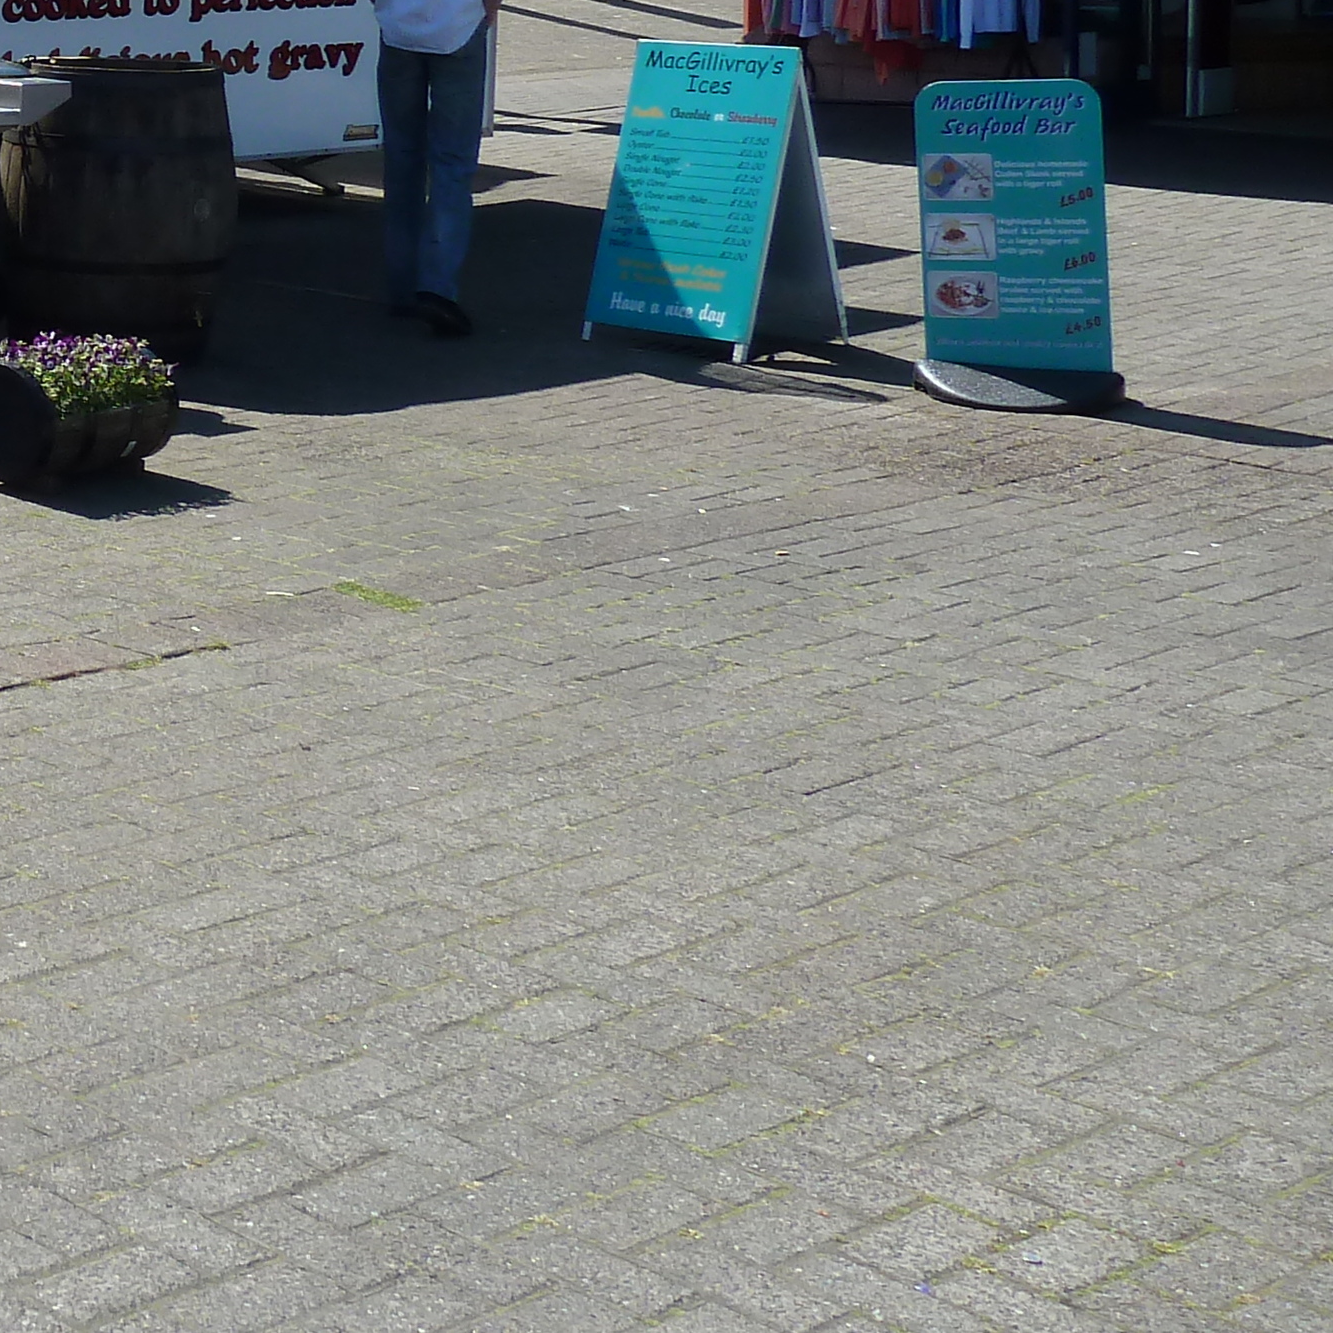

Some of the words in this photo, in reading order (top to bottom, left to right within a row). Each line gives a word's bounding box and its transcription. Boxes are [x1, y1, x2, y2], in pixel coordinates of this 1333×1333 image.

[201, 40, 260, 75] hot
[267, 39, 364, 80] gravy
[645, 50, 784, 80] MacGillivray's
[686, 74, 733, 95] Ices
[932, 91, 1085, 116] MacGillivray's
[940, 116, 1026, 142] Seafood
[1034, 119, 1076, 135] Bar
[1060, 187, 1094, 208] £5.00
[610, 291, 646, 314] Have
[650, 303, 660, 315] a
[664, 301, 694, 319] nice
[698, 301, 727, 328] day
